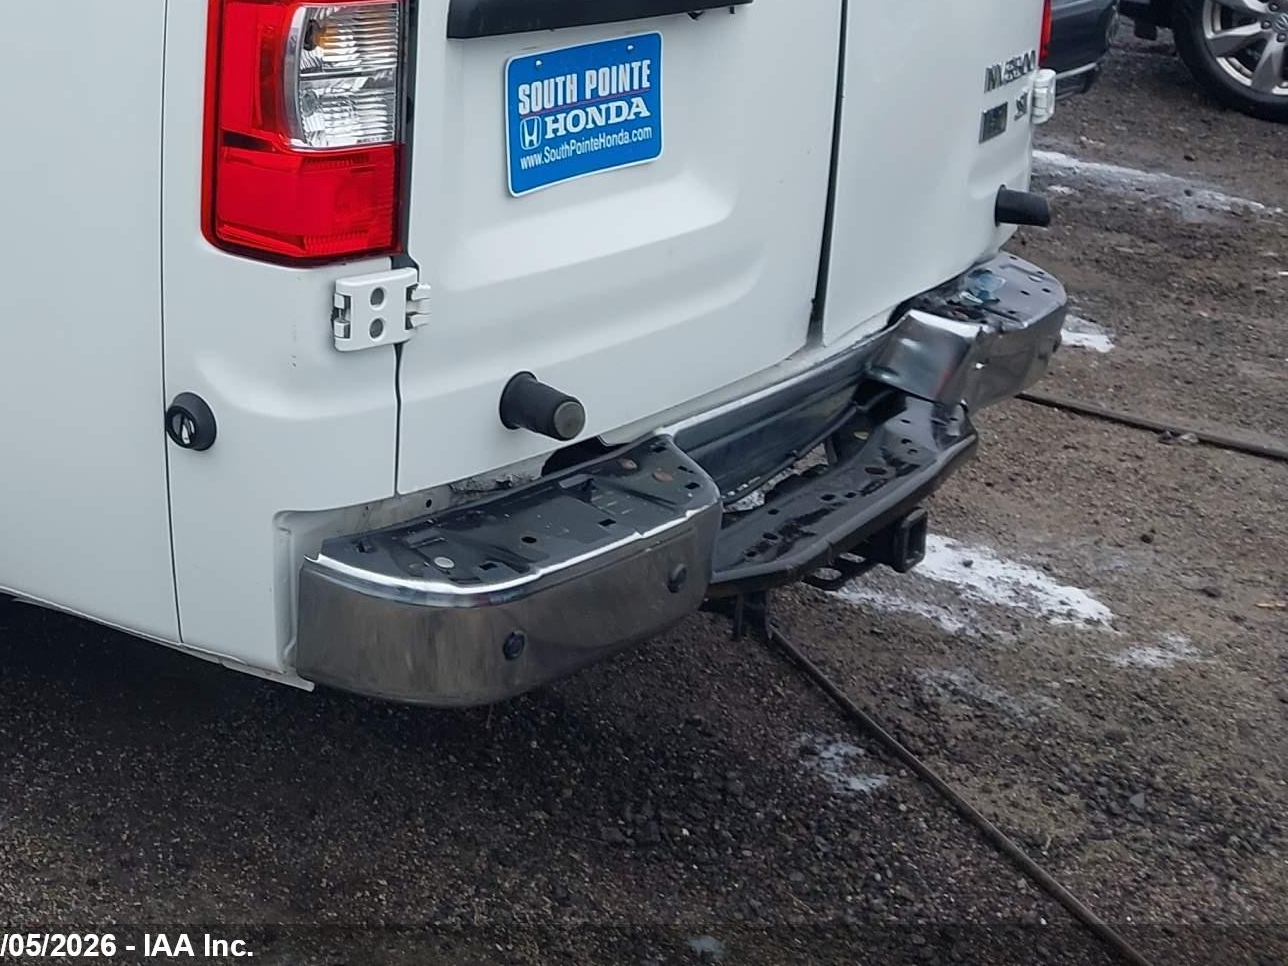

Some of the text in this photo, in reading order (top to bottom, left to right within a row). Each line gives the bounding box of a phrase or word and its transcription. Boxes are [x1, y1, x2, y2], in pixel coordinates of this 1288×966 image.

[518, 59, 651, 115] SOUTH POINTE
[544, 97, 651, 139] HONDA
[520, 126, 653, 170] www.SouthPointeHonda.com
